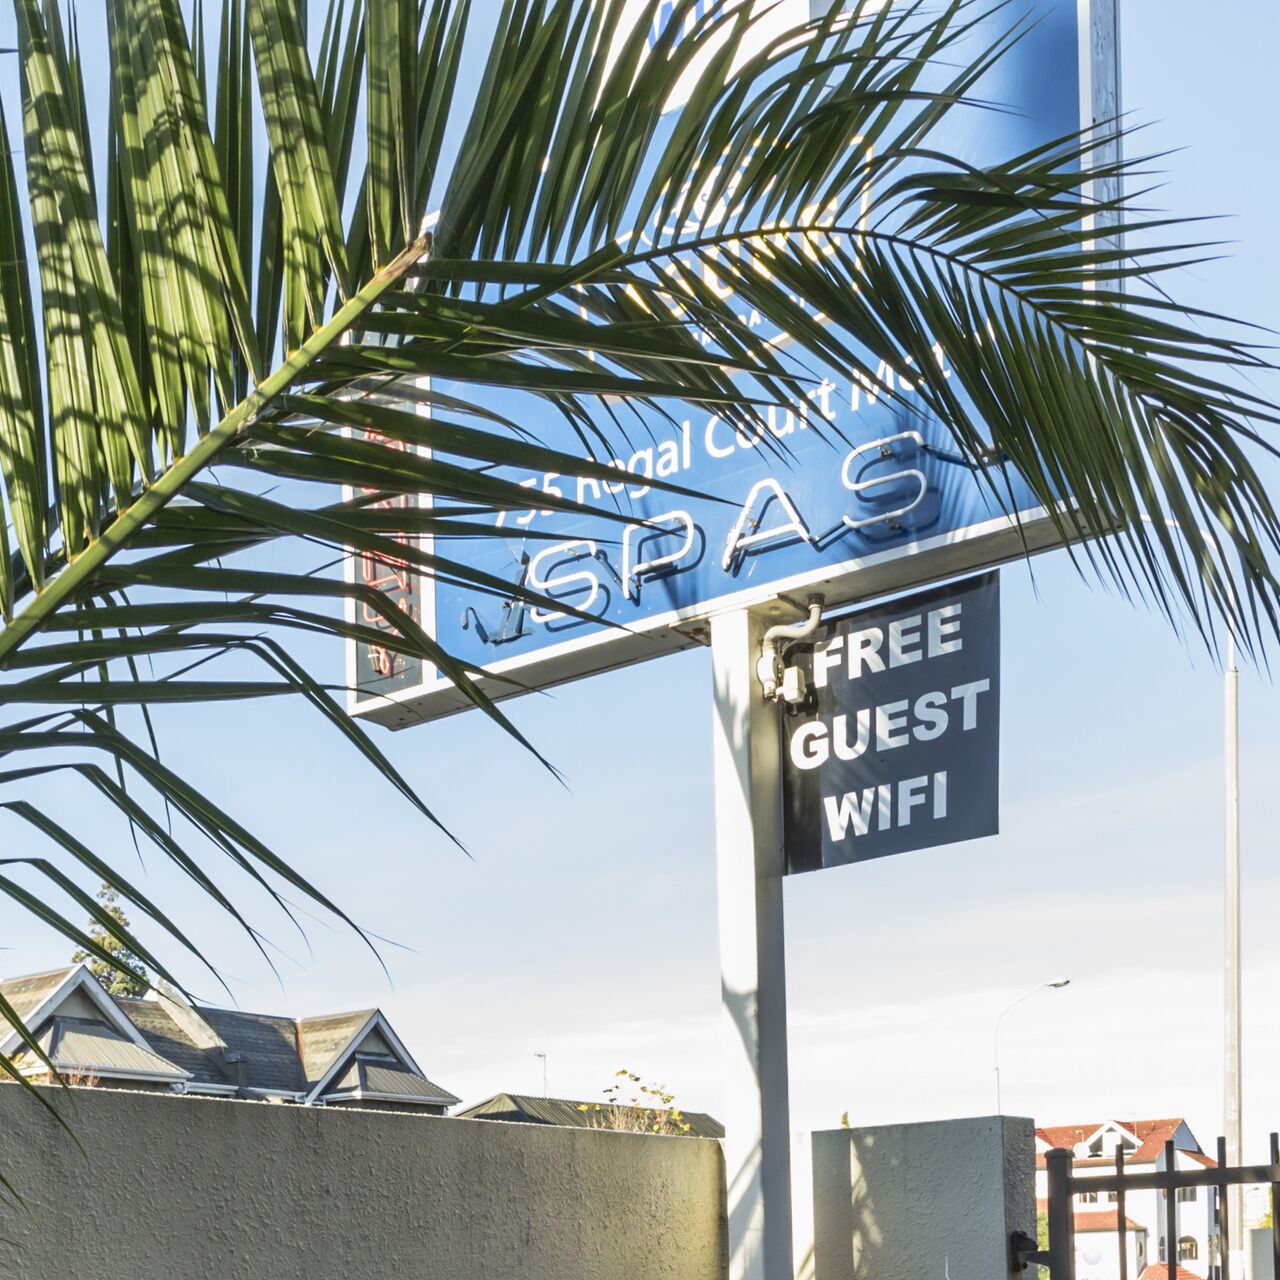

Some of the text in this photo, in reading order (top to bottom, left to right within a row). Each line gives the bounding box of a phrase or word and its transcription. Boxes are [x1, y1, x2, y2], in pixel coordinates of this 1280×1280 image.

[705, 377, 836, 458] Court
[529, 430, 927, 622] SPAS
[814, 603, 963, 689] FREE
[790, 678, 991, 770] GUEST
[823, 770, 948, 842] WIFI
